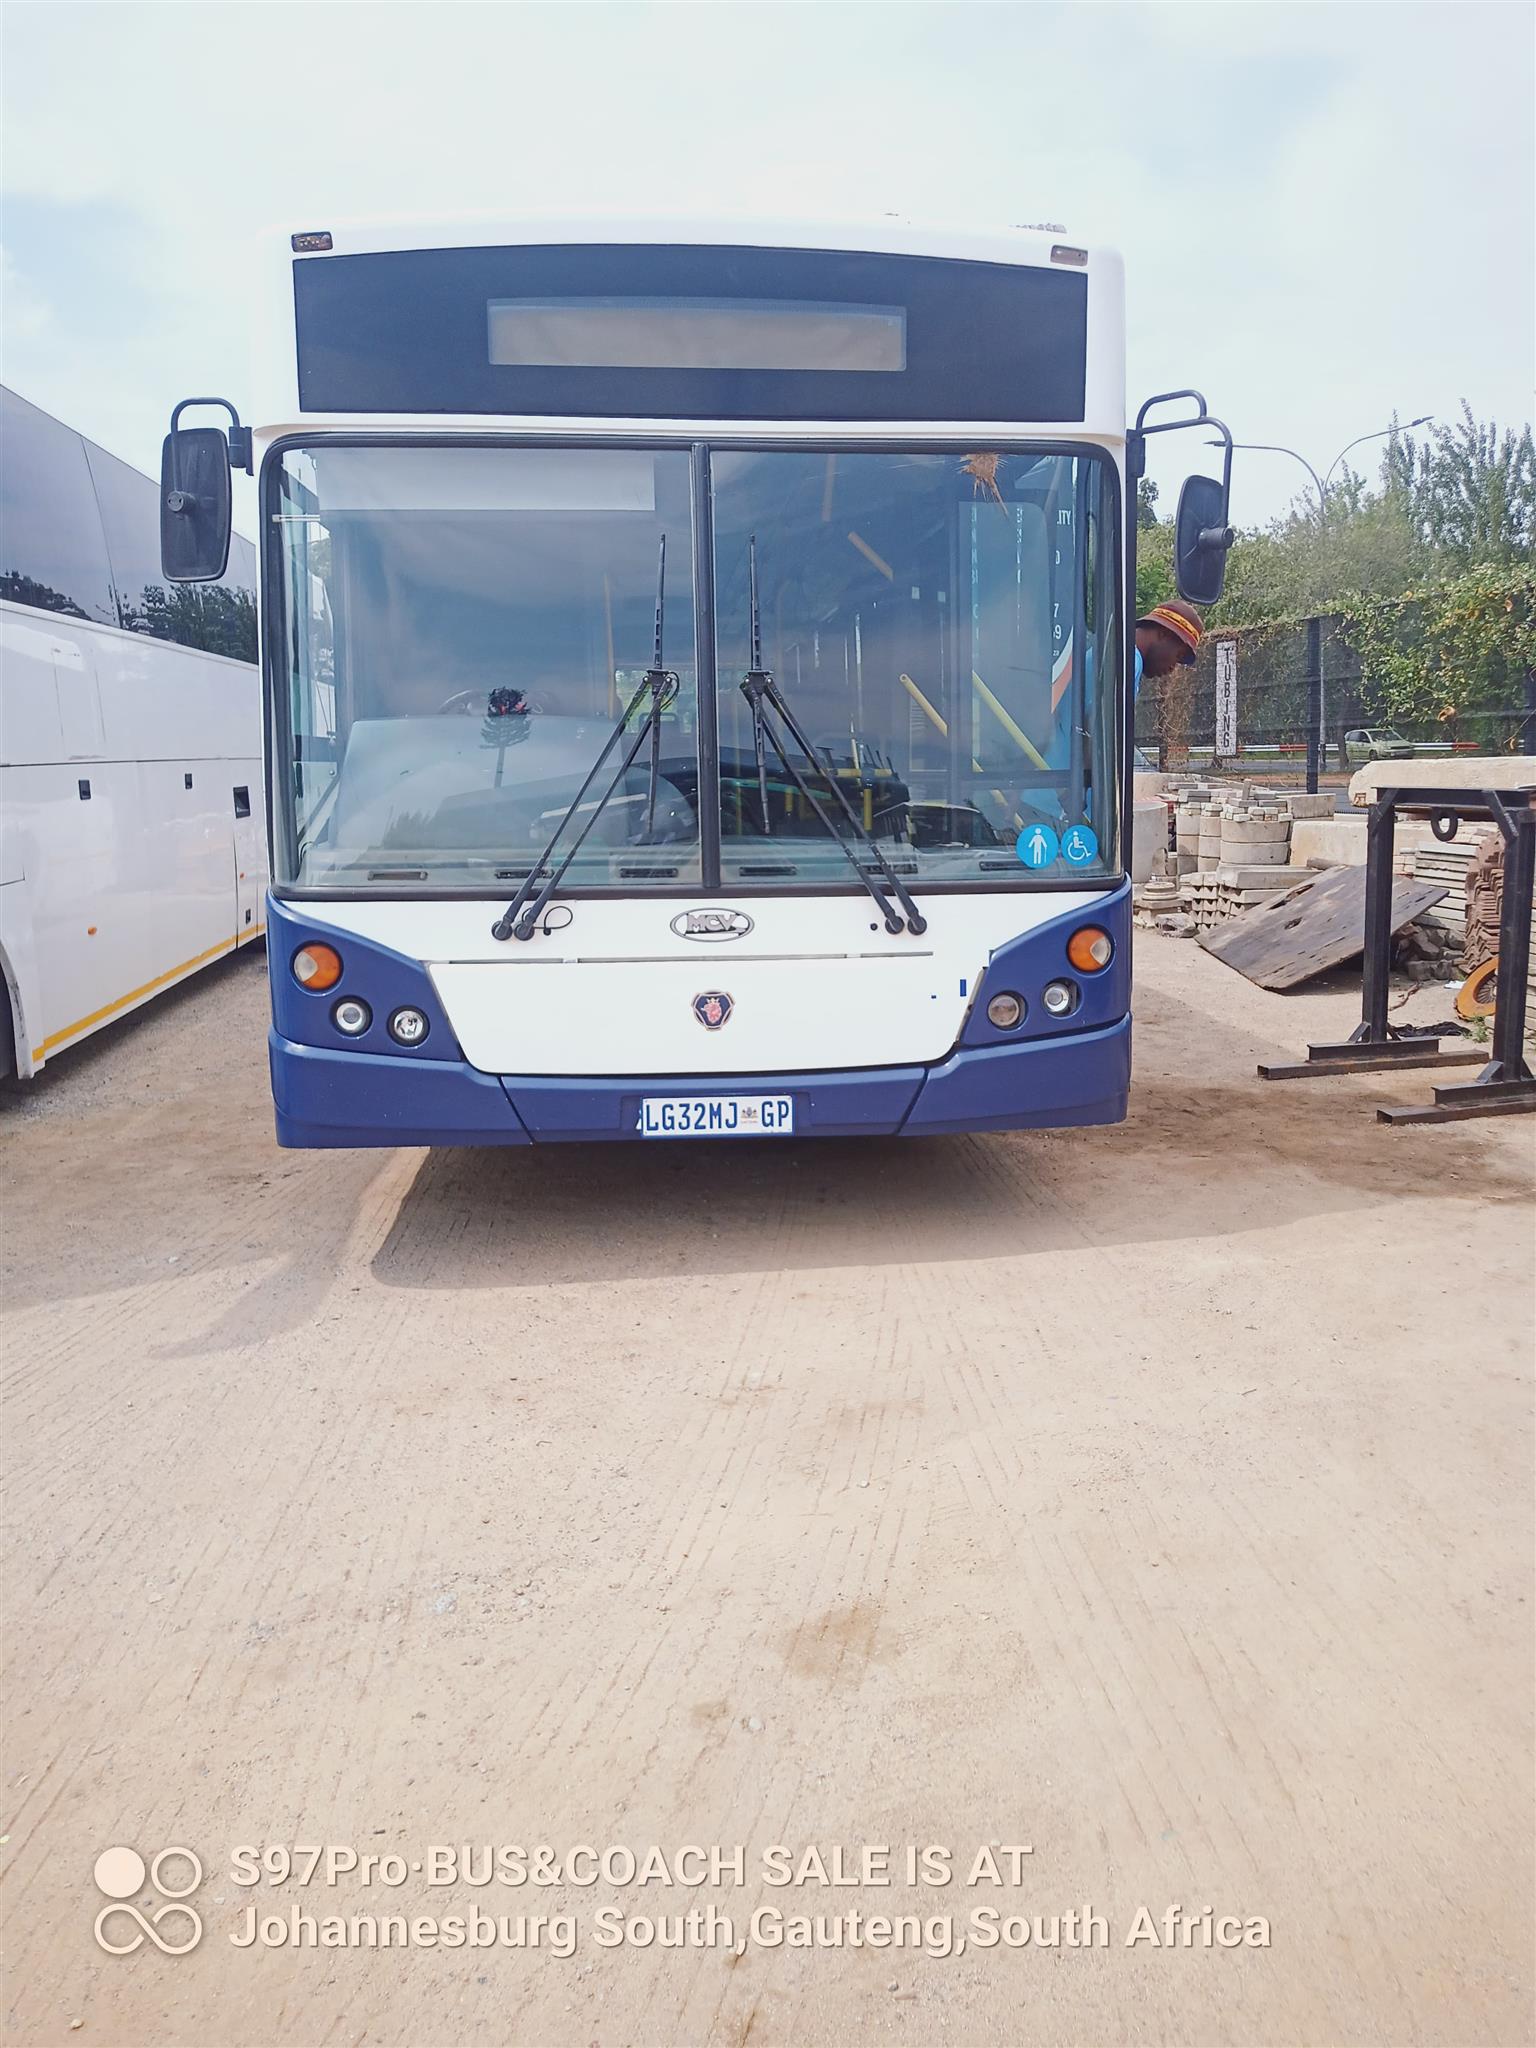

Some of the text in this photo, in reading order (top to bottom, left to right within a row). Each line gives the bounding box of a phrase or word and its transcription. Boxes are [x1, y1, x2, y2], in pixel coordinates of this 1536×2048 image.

[1222, 647, 1234, 748] TUBING
[686, 913, 738, 932] MCV
[645, 1100, 790, 1131] LG32MJ GP
